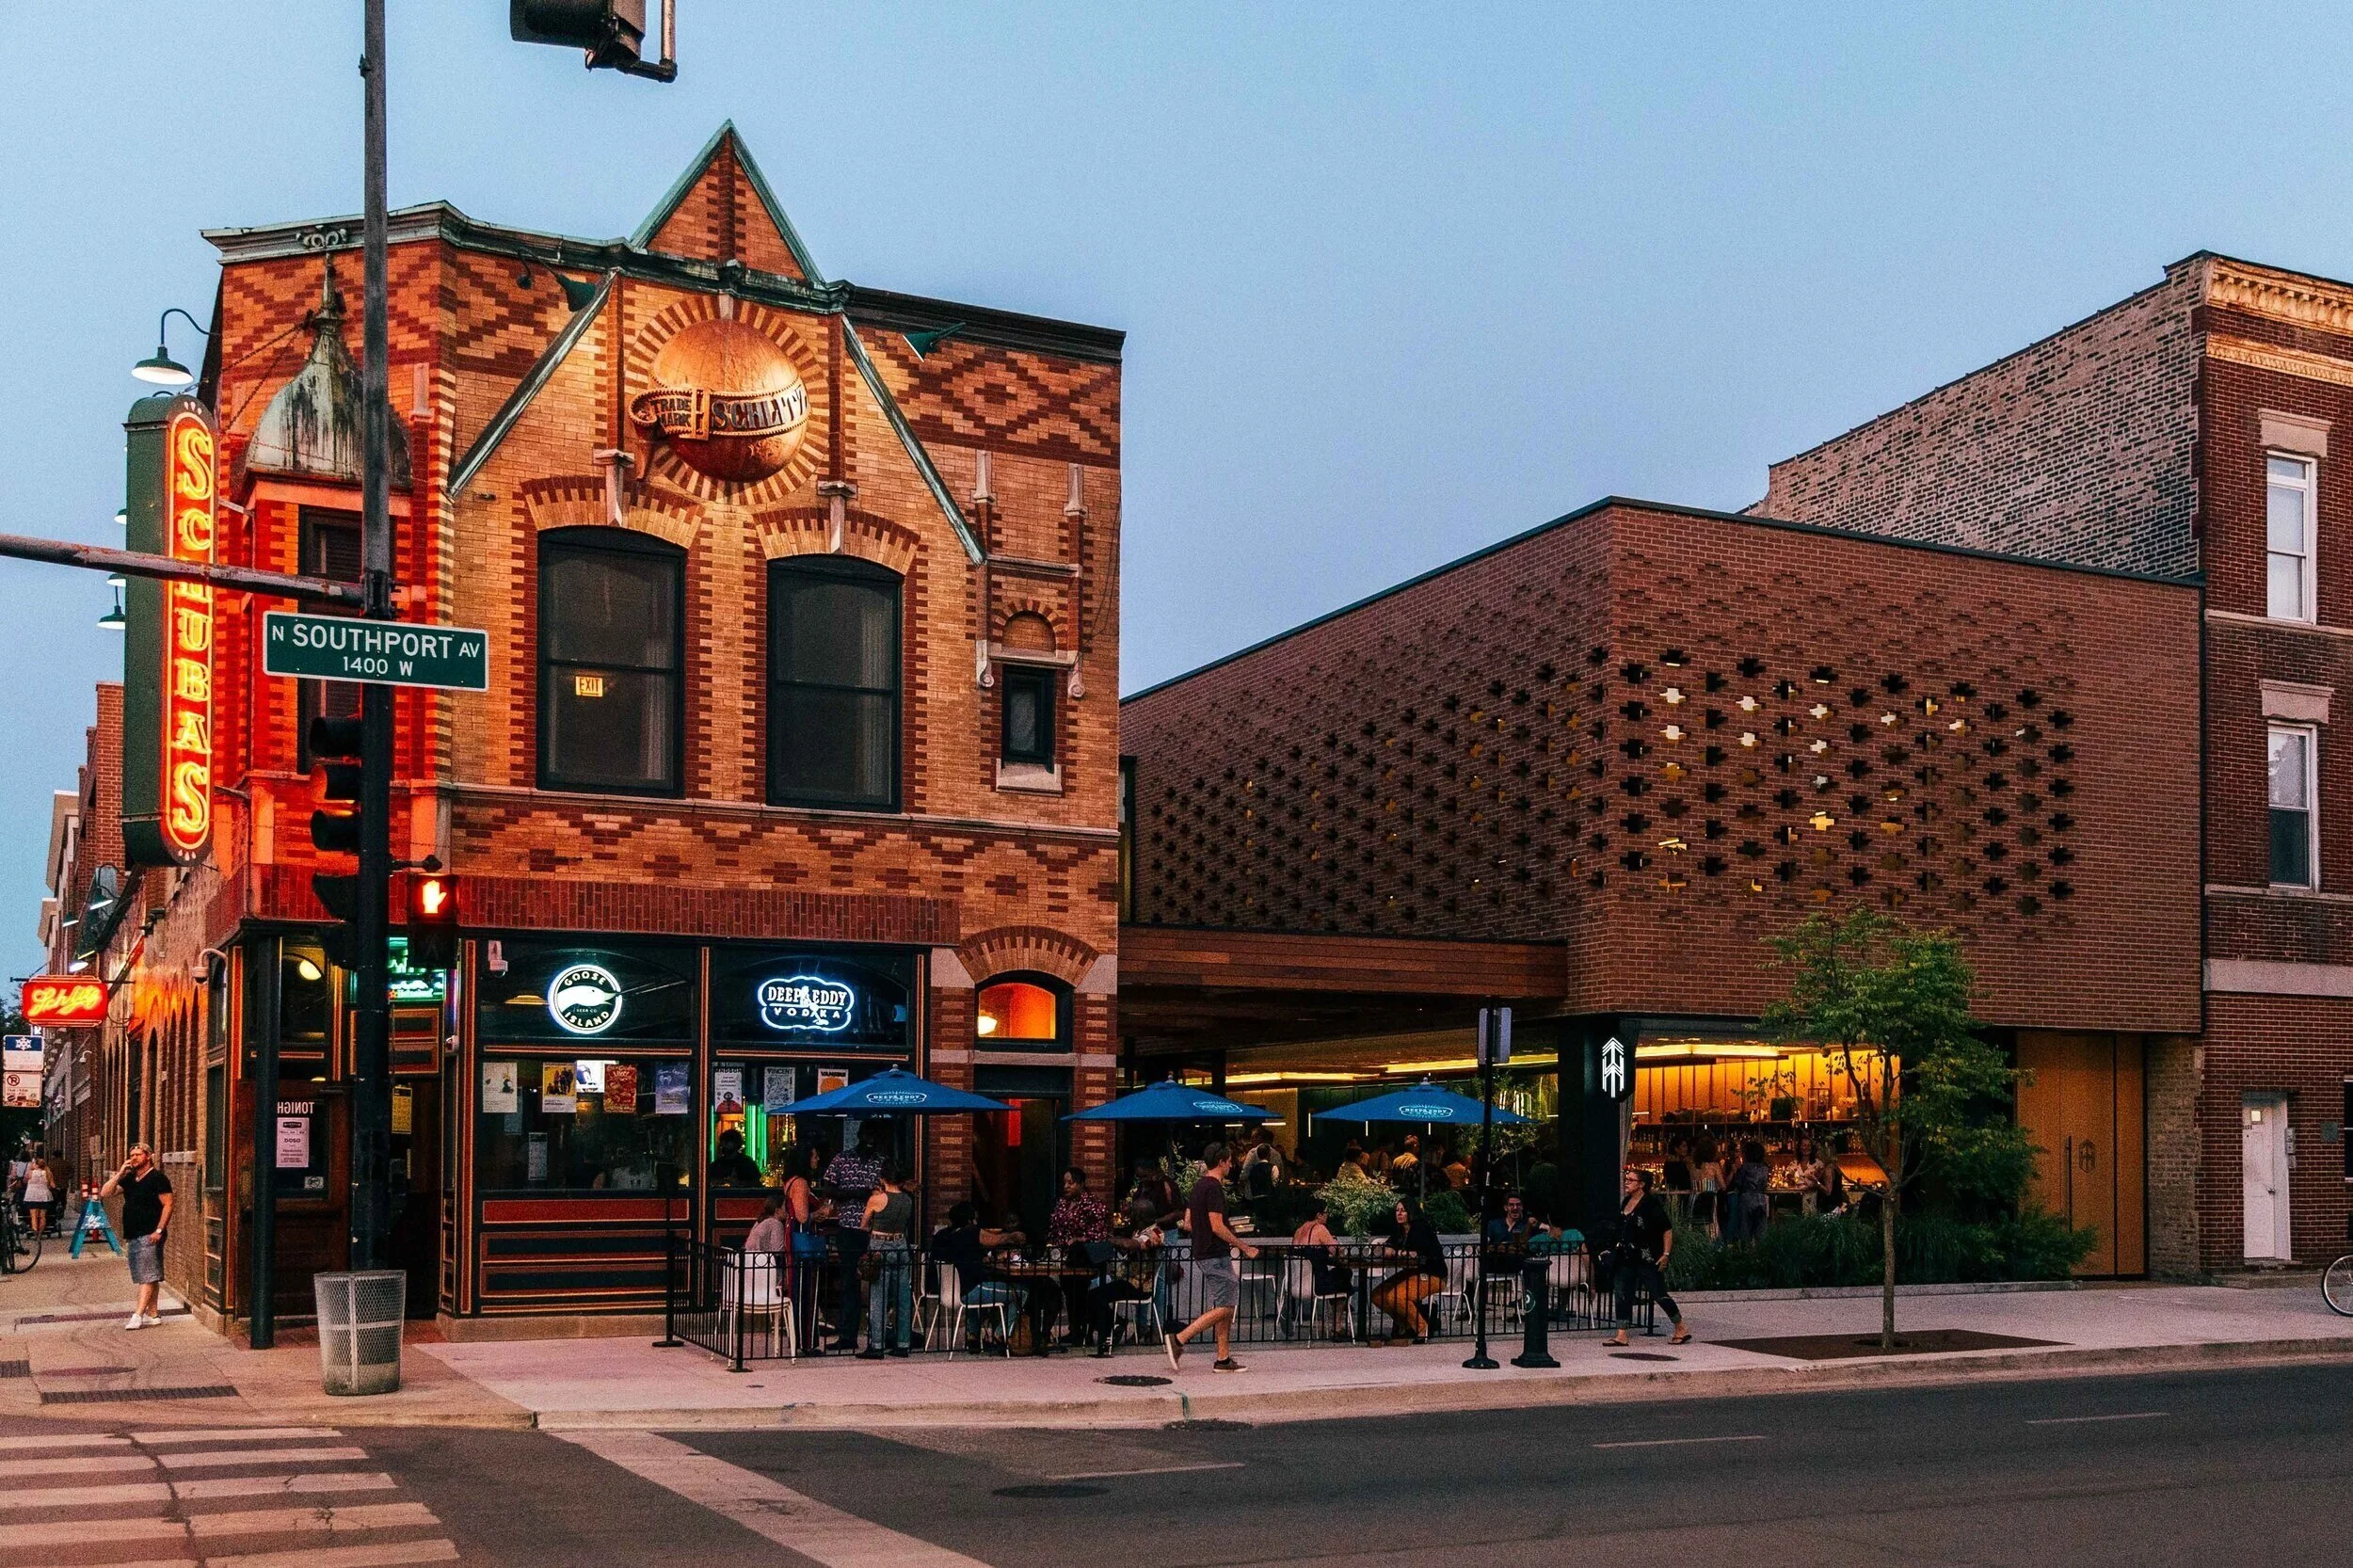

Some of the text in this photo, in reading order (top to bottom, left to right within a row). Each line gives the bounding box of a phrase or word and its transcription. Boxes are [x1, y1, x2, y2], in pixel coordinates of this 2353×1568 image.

[649, 398, 692, 412] TRADE
[272, 623, 480, 659] N SOUTHPORT AV
[343, 656, 413, 677] 1400 W
[579, 678, 600, 693] EXIT
[565, 970, 606, 986] GOOSE
[767, 986, 847, 1006] DEEP EDDY
[565, 1012, 610, 1028] ISLAND
[774, 1007, 840, 1019] VODKA
